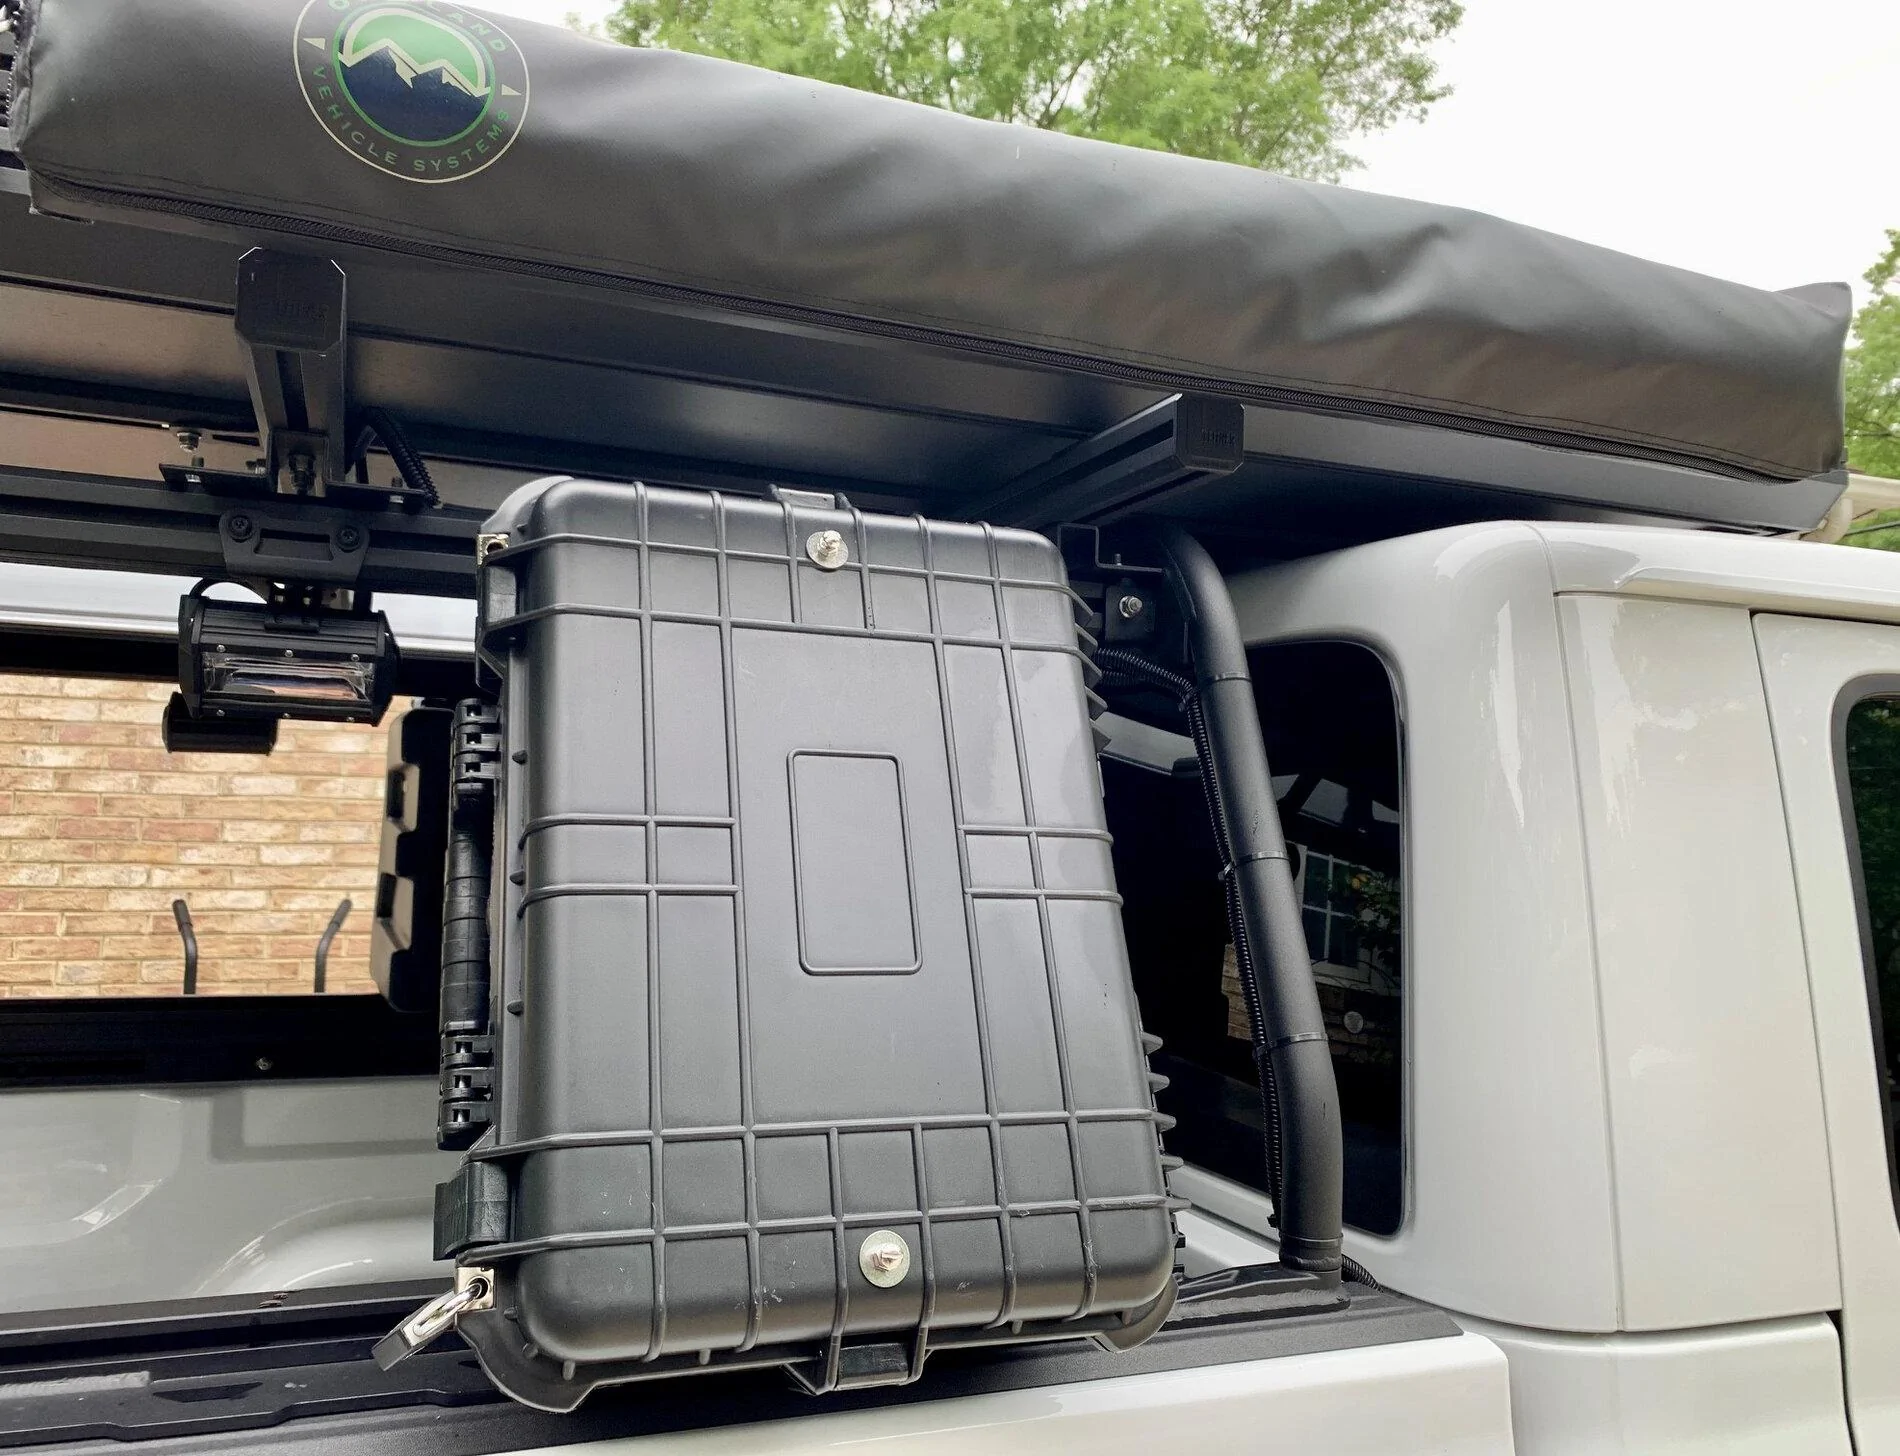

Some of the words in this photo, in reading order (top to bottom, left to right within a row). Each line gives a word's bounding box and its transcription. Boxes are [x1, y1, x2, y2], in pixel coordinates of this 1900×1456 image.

[328, 0, 507, 52] OLAND
[312, 65, 400, 166] VEHICLE
[413, 109, 510, 172] SYSTEMS
